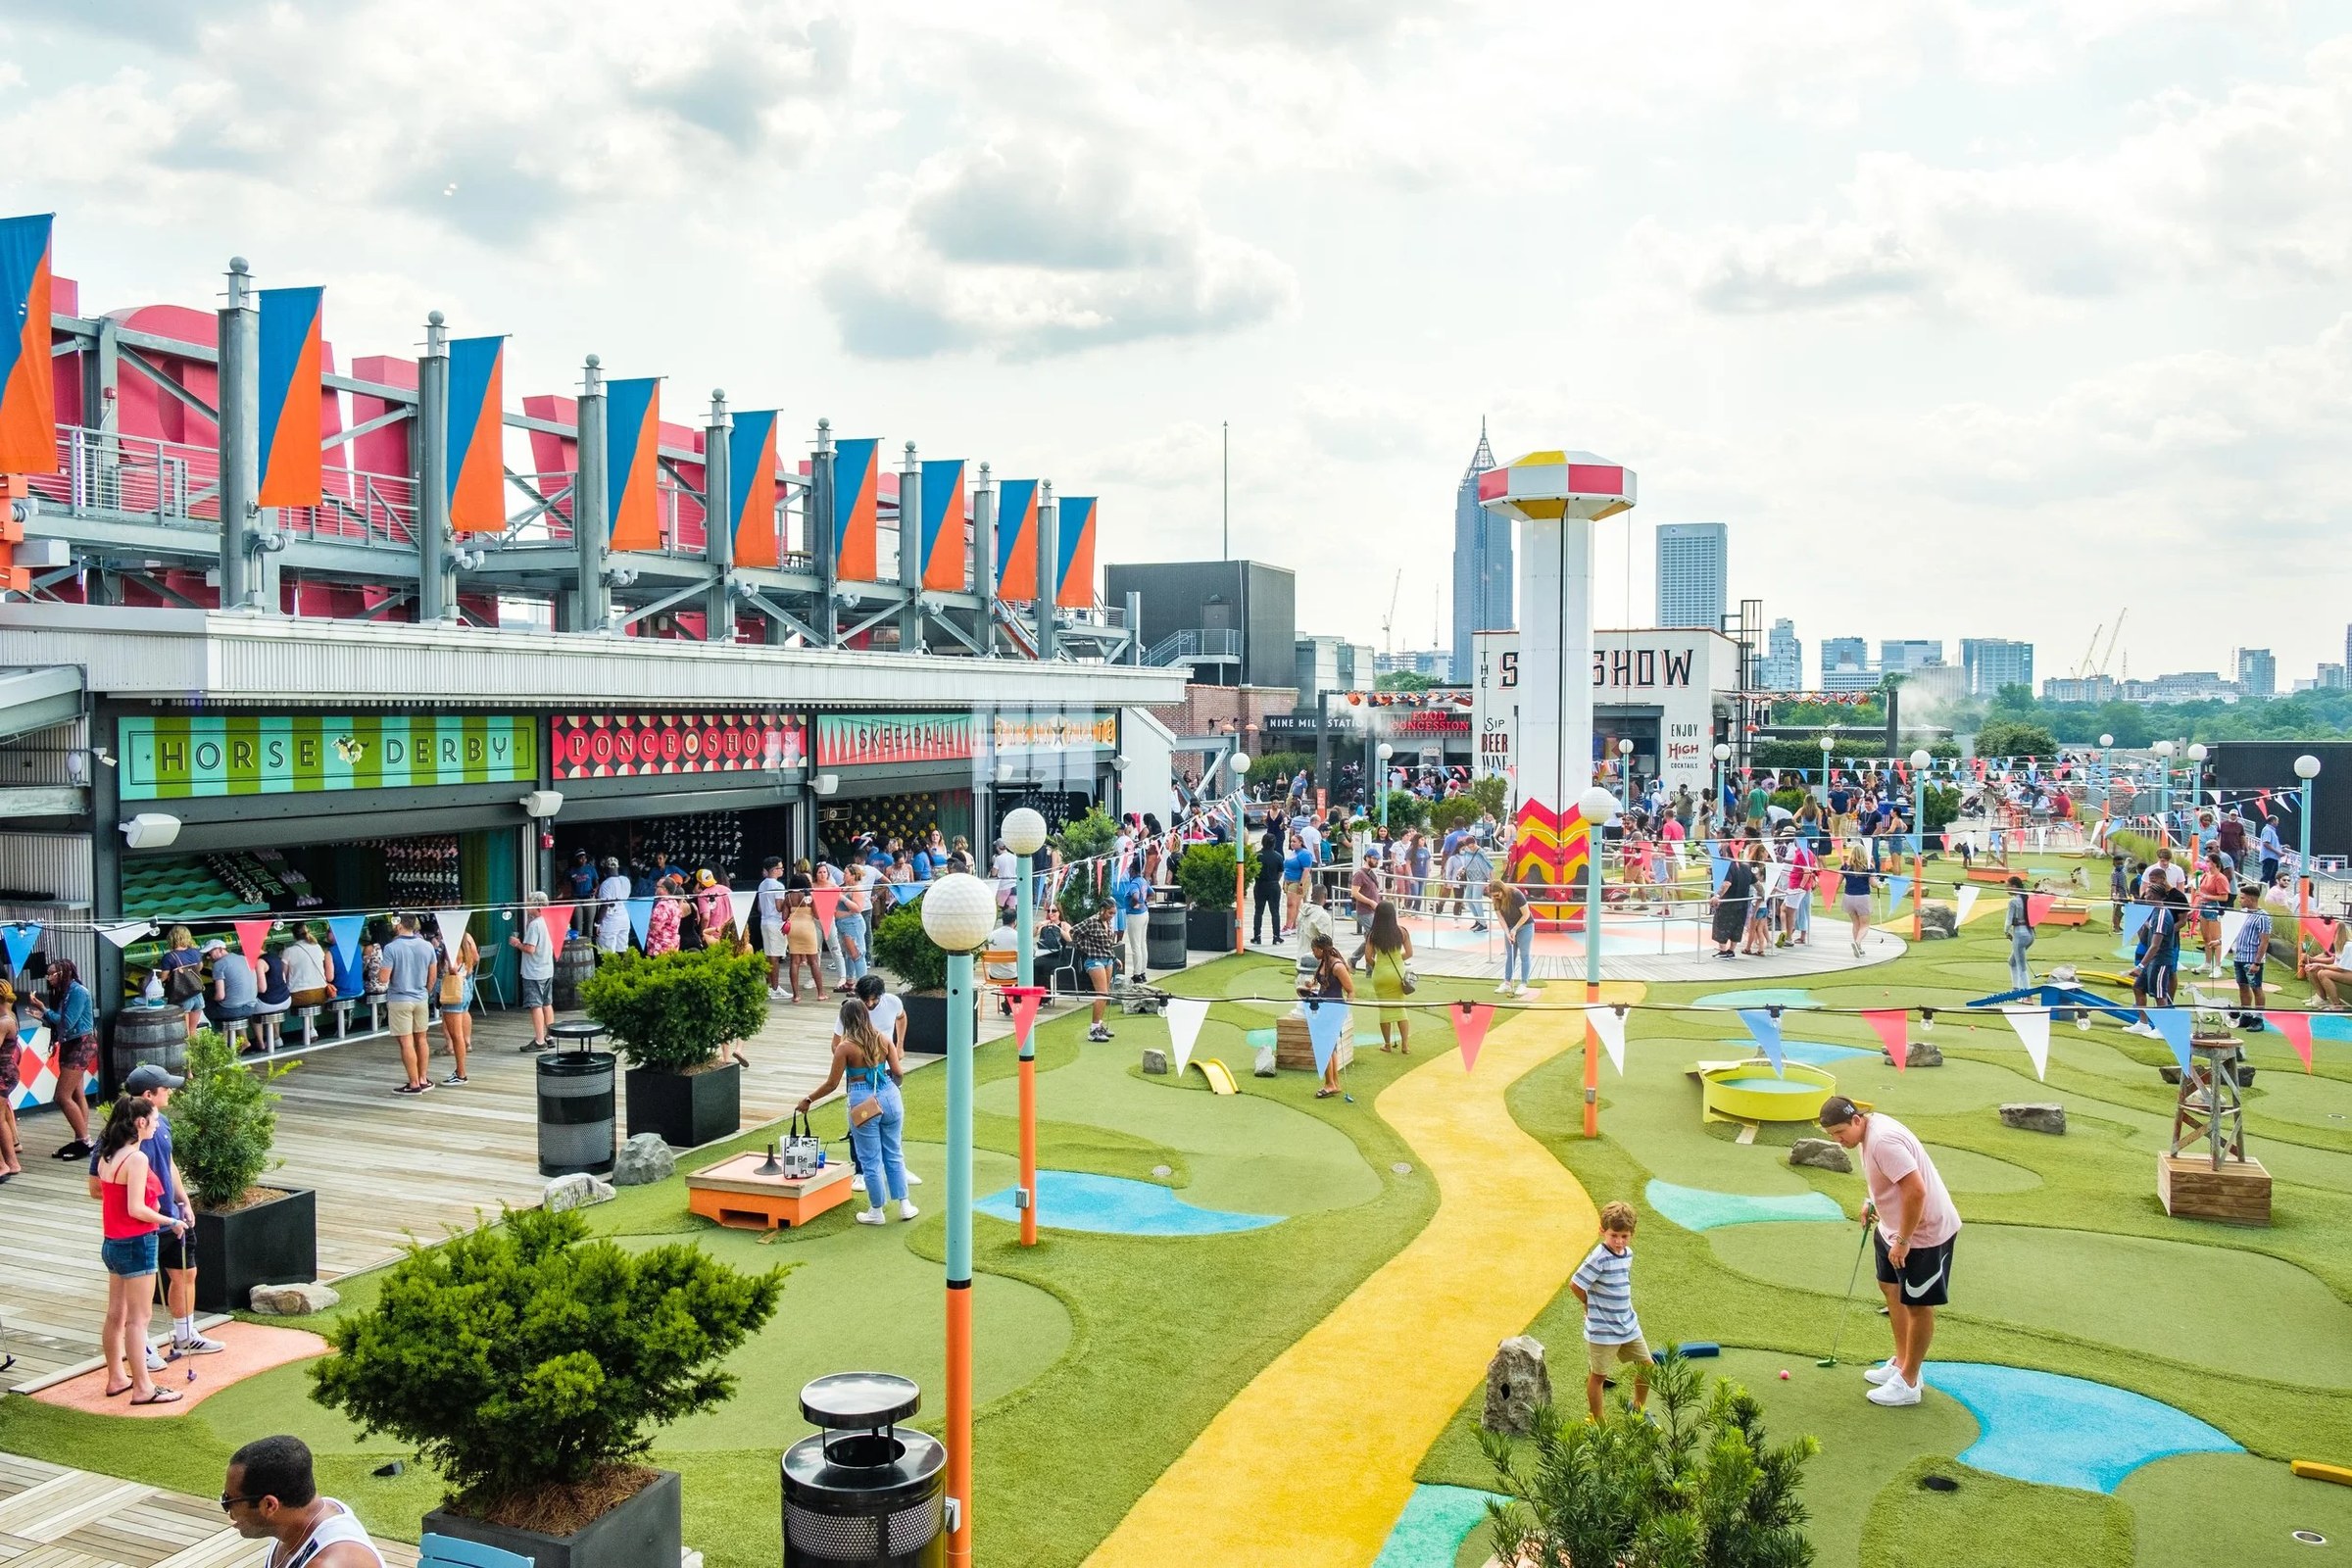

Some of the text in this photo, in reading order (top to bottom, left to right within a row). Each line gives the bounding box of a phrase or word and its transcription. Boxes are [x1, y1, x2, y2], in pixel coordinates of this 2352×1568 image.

[1479, 651, 1491, 689] THE
[1269, 717, 1364, 728] NINE MIL STATIO
[1412, 710, 1447, 721] FOOD
[1391, 720, 1469, 731] CONCESSION
[1671, 723, 1698, 737] ENJOY
[572, 732, 795, 759] PONCE SHOTS
[858, 725, 954, 750] SKEE-BALL
[1481, 733, 1508, 754] BEER
[161, 736, 508, 772] HORSE DERBY
[1481, 755, 1509, 771] WINE
